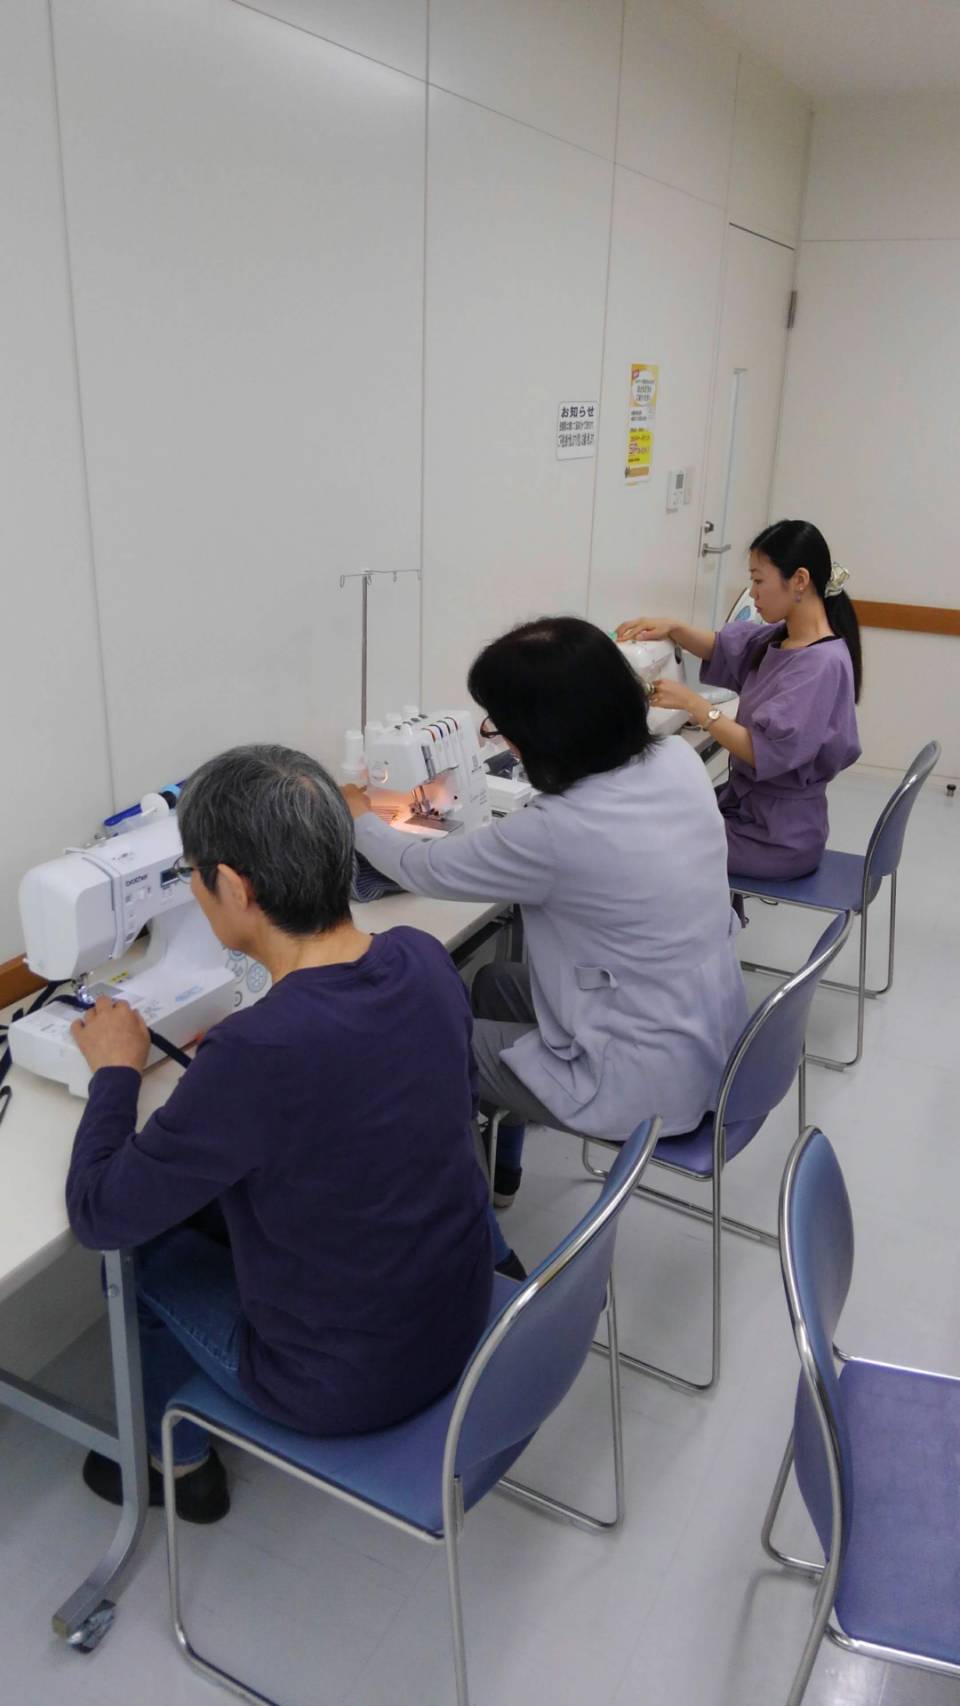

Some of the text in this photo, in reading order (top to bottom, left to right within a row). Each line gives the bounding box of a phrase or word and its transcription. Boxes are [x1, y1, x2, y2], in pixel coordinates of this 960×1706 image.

[561, 406, 594, 418] お知らせ
[125, 874, 148, 887] brother
